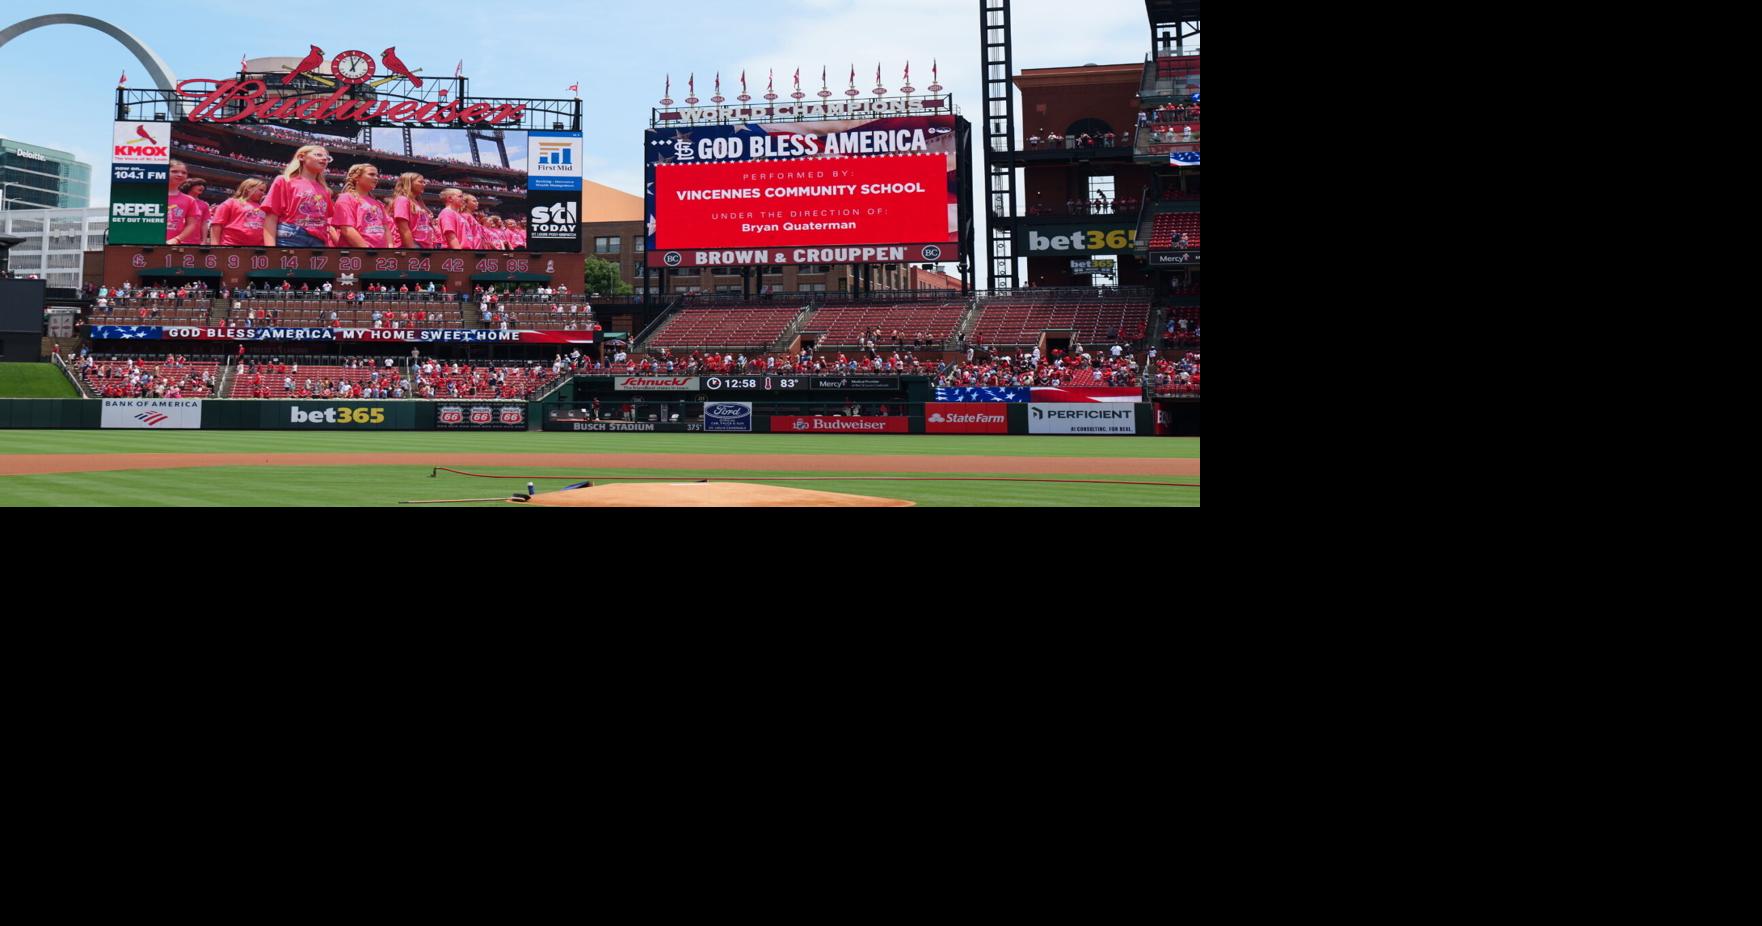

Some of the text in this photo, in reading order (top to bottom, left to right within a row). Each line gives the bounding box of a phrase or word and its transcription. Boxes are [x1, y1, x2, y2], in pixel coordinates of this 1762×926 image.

[176, 79, 527, 125] Budweiser
[680, 99, 924, 122] WORLD CHAMPIONS
[114, 145, 168, 156] KMOX
[698, 137, 744, 160] GOD
[750, 133, 818, 157] BLESS
[824, 128, 927, 154] AMERICA
[114, 171, 166, 180] 104.1 FM
[743, 171, 825, 181] PERFORMED
[676, 182, 926, 201] VINCENNES COMMUNITY SCHOOL
[112, 203, 165, 217] REPEL
[531, 202, 577, 224] stl
[712, 212, 754, 220] UNDER
[790, 209, 860, 218] DIRECTION
[868, 208, 888, 216] OF:
[532, 224, 577, 232] TODAY
[742, 220, 856, 234] Bryan Quaterman
[666, 254, 679, 263] BC
[696, 247, 905, 265] BROWN & CROUPPEN
[925, 248, 938, 257] BC
[1160, 255, 1183, 263] Mercy
[165, 254, 173, 268] 1
[182, 254, 195, 268] 2
[205, 255, 217, 268] 6
[228, 255, 240, 269] 9
[251, 256, 268, 270] 10
[280, 256, 298, 270] 14
[310, 256, 328, 270] 17
[339, 256, 362, 271] 20
[376, 257, 398, 272] 23
[408, 258, 430, 272] 24
[442, 258, 464, 273] 42
[476, 258, 499, 273] 45
[506, 258, 529, 273] 85
[1070, 259, 1114, 268] bet365
[169, 328, 520, 341] GOD BLESS AMERICA, MY HOME SWEET HOME
[620, 378, 692, 386] Schnucks
[725, 379, 756, 388] 12:58
[780, 379, 799, 388] 83°
[290, 406, 385, 424] bet365
[713, 405, 742, 416] Ford
[1048, 410, 1132, 419] PERFICIENT
[574, 423, 654, 431] BUSCH STADIUM
[813, 418, 886, 430] Budweiser
